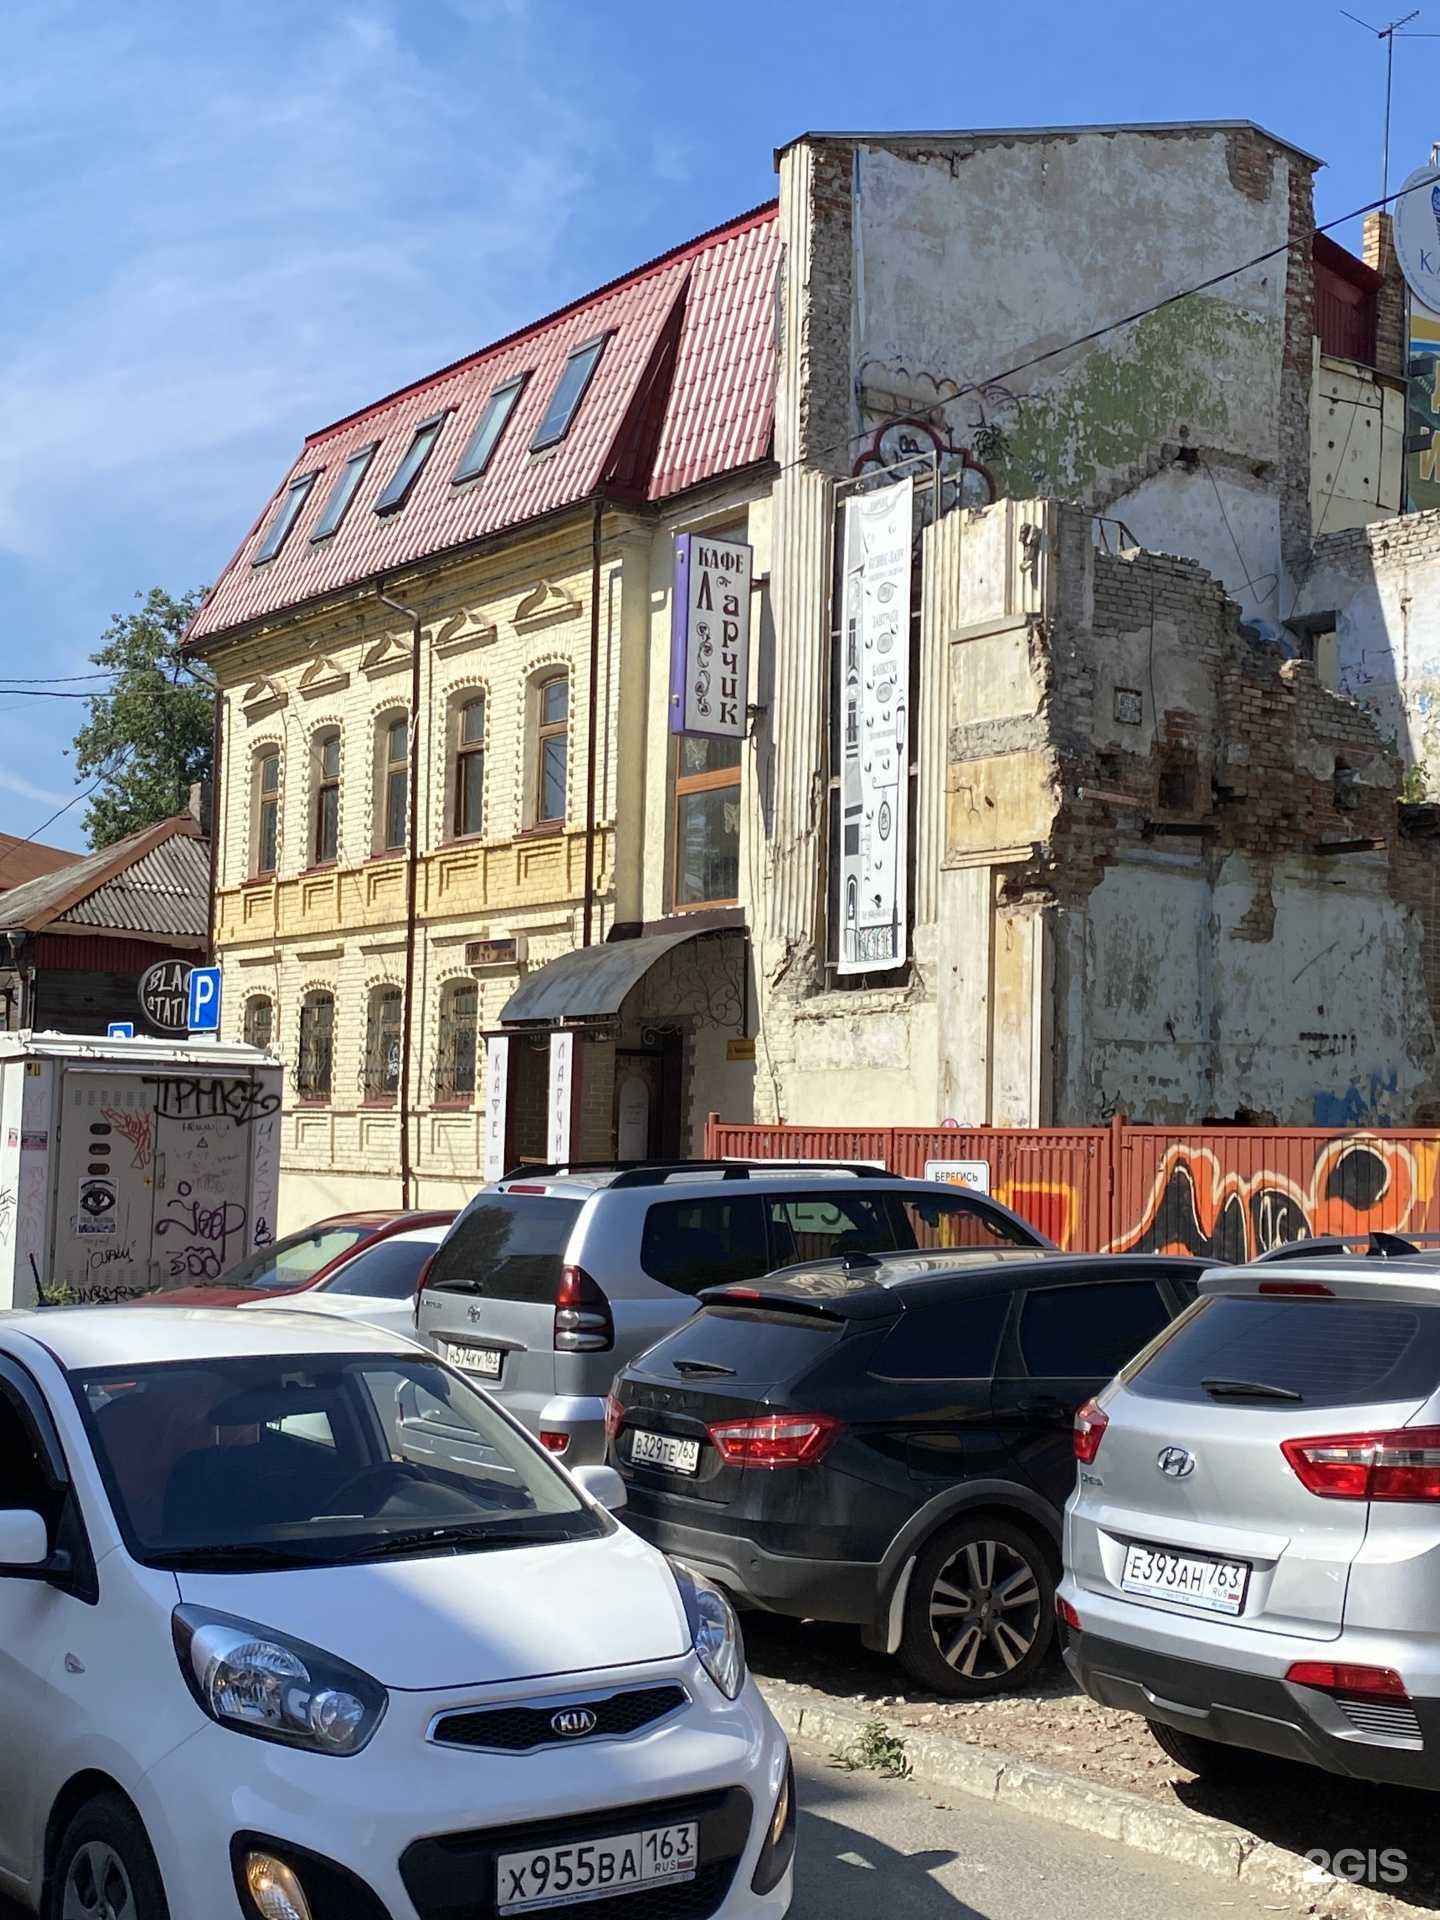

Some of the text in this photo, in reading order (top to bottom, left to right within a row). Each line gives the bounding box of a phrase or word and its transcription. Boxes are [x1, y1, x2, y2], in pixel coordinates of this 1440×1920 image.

[698, 546, 744, 574] КАФЕ
[147, 995, 187, 1025] STATI
[194, 976, 214, 1023] P
[935, 1171, 978, 1182] БЕРЕГИСЬ
[635, 1434, 696, 1463] В329ТЕ 763
[1130, 1552, 1240, 1591] Е393АН 763
[1212, 1587, 1228, 1598] RUS
[560, 1712, 590, 1731] KIA
[508, 1846, 637, 1900] Х955ВА
[646, 1827, 690, 1862] 163
[654, 1860, 677, 1874] RUS
